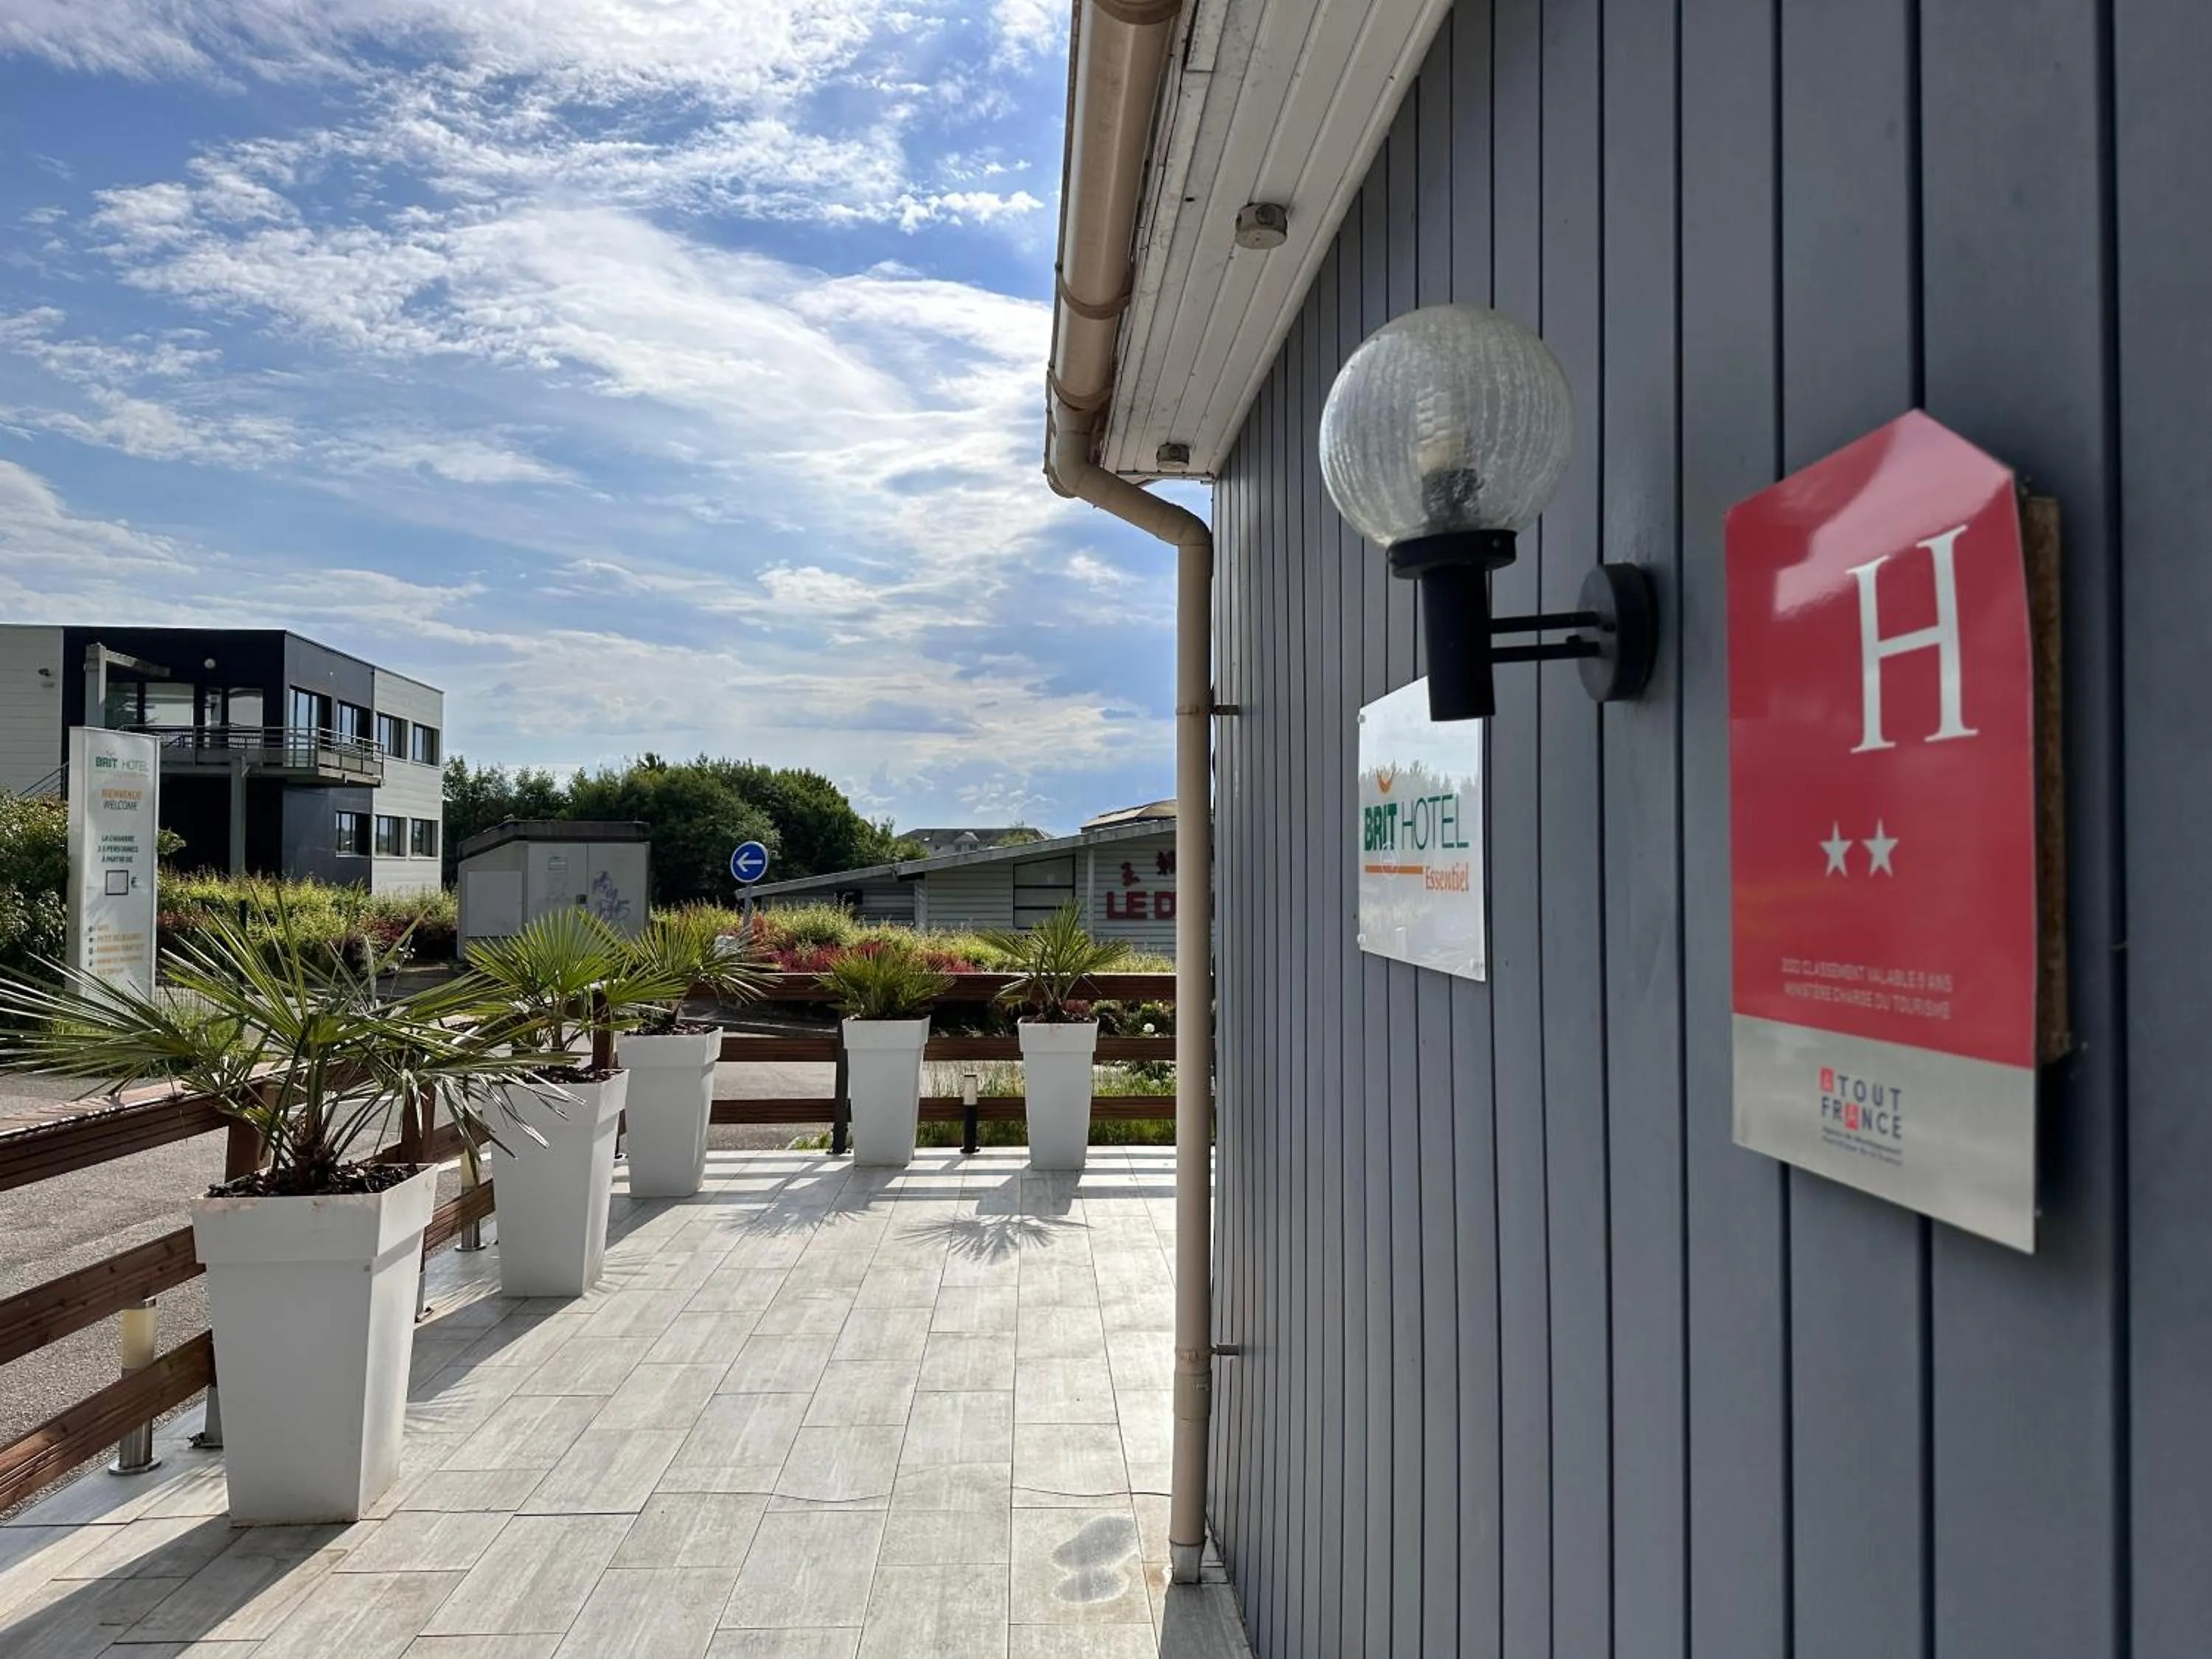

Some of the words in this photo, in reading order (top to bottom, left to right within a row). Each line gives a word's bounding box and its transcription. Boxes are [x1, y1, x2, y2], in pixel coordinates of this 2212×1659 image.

[1844, 524, 1979, 754] H
[95, 756, 118, 768] BRIT
[122, 759, 150, 772] HOTEL
[104, 800, 139, 811] WELCOME
[1364, 801, 1397, 851] BRIT
[1402, 793, 1470, 850] HOTEL
[1425, 861, 1470, 892] Essentiel
[1154, 891, 1178, 919] D
[1820, 1096, 1902, 1141] FRANCE
